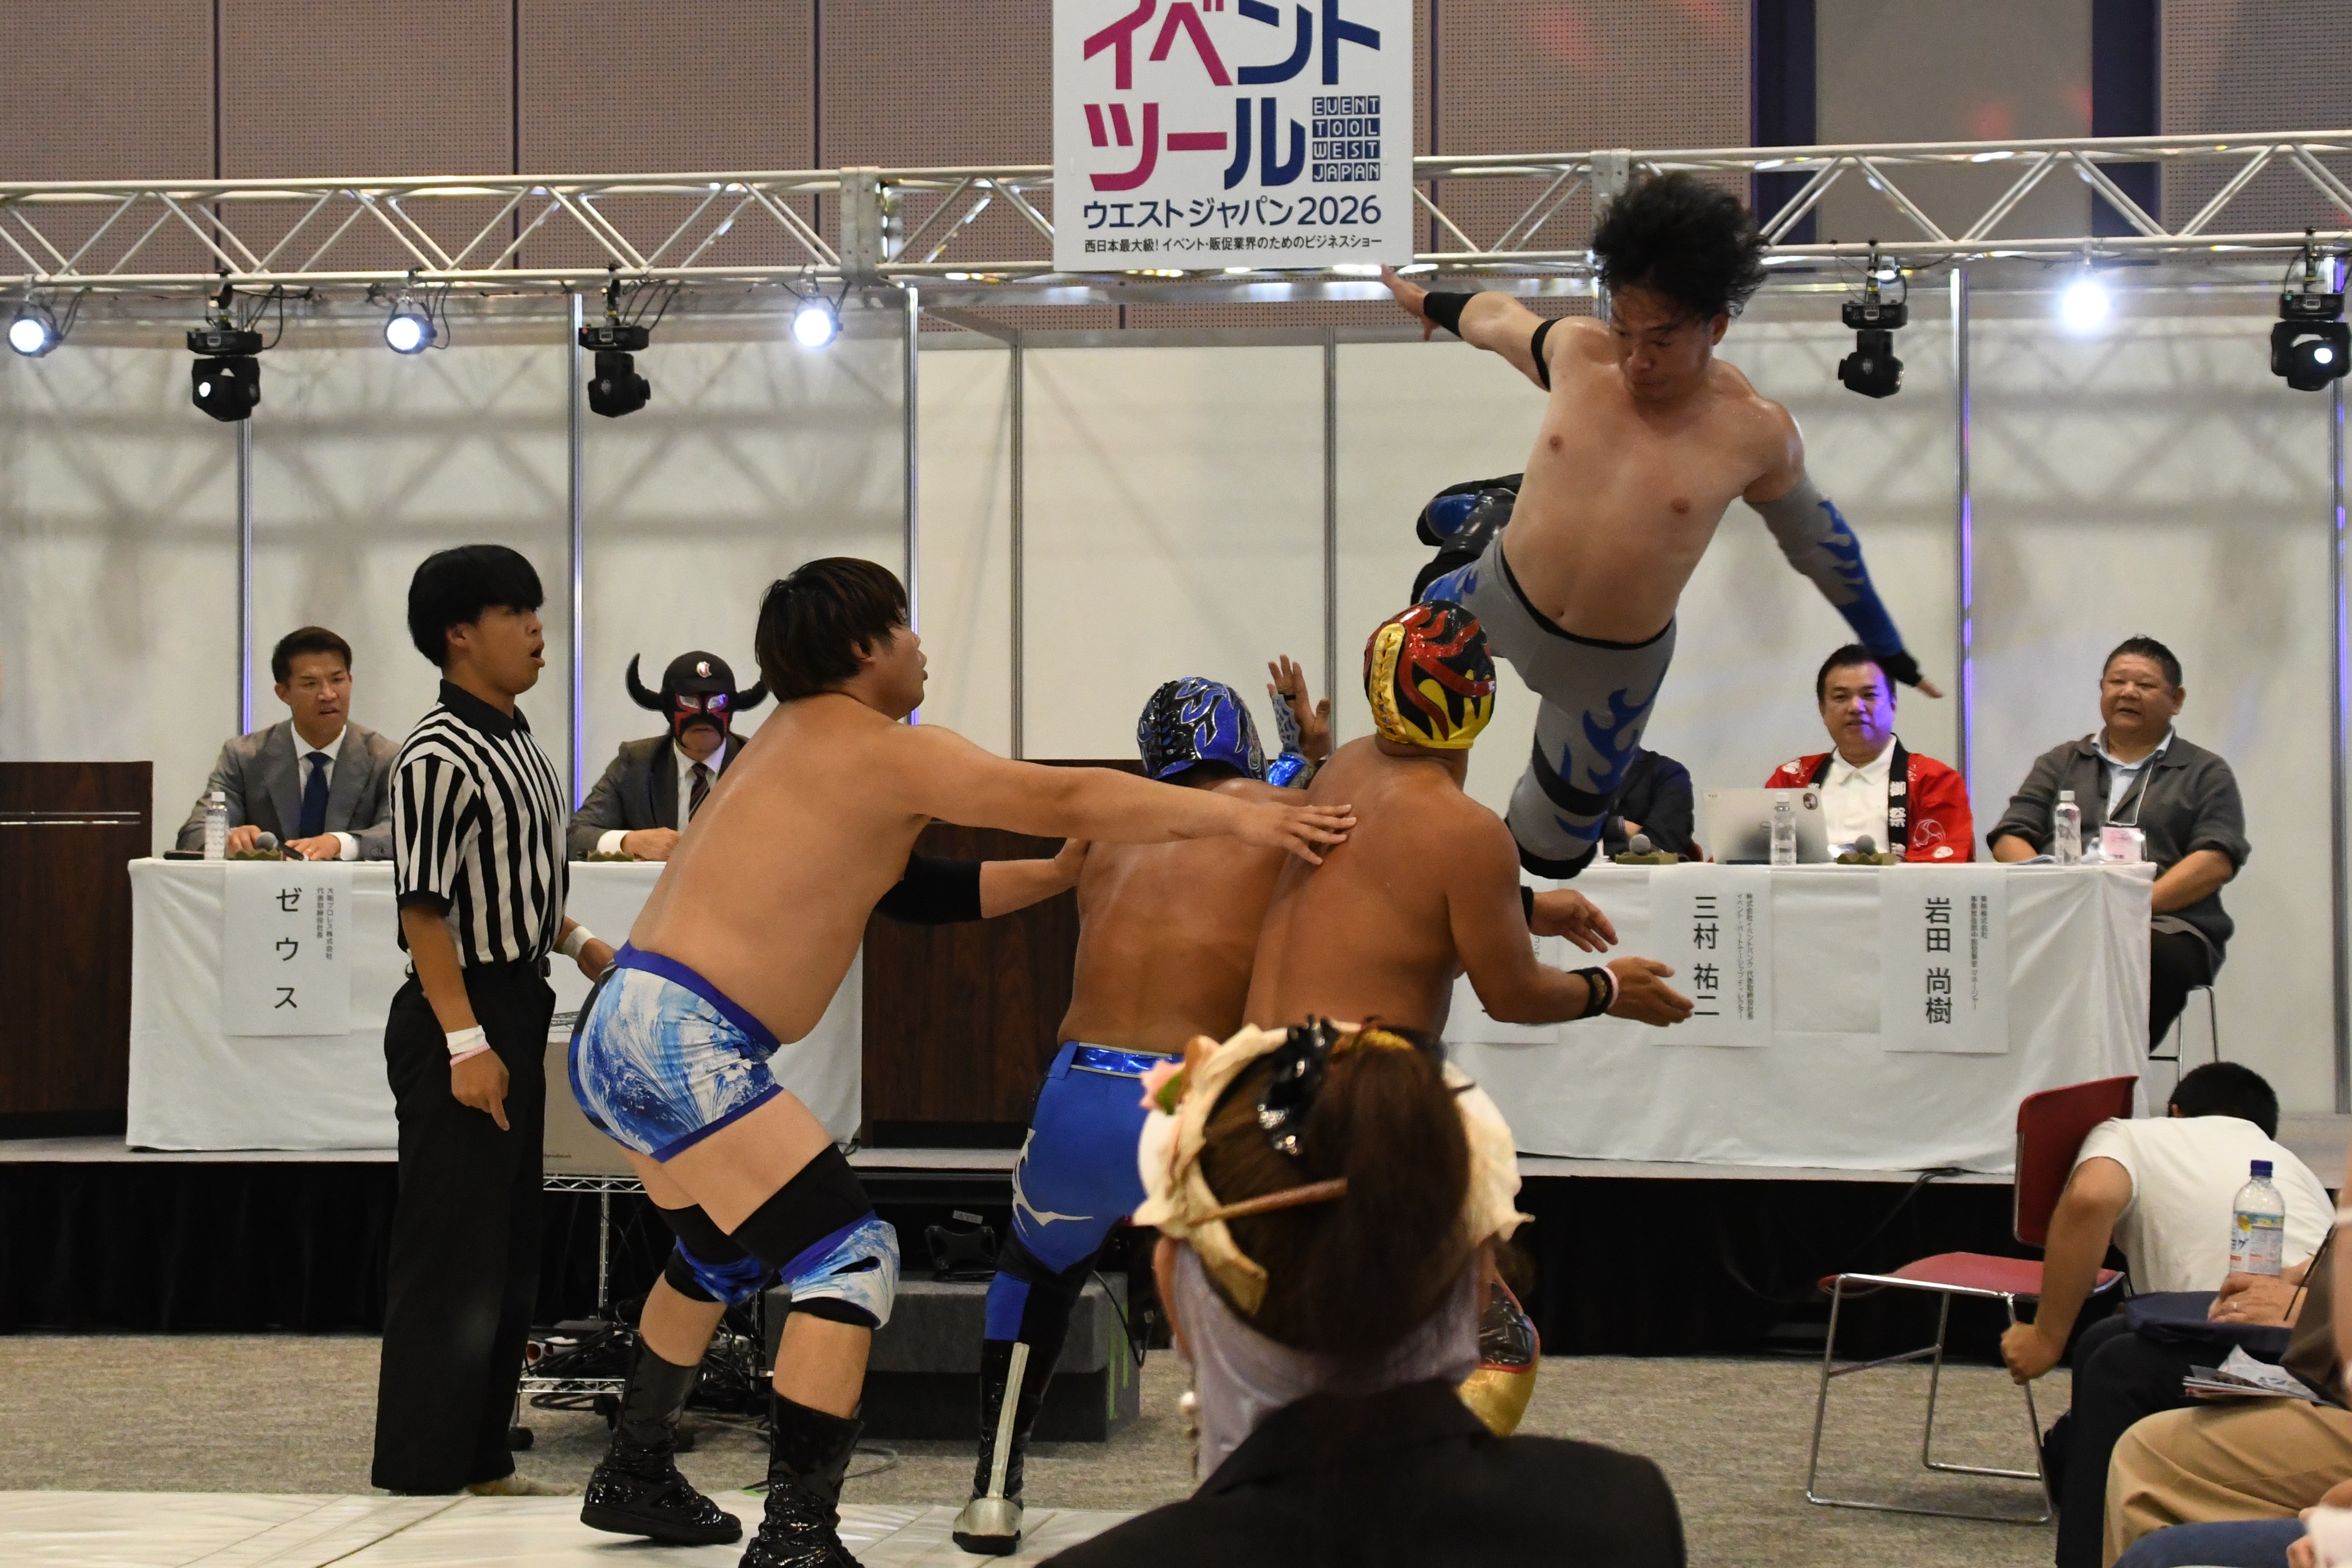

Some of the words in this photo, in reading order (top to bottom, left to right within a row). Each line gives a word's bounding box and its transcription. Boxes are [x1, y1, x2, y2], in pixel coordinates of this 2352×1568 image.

[1084, 0, 1380, 89] イベント
[1314, 98, 1379, 115] EVENT
[1315, 120, 1378, 136] TOOL
[1084, 97, 1307, 192] ツール
[1314, 141, 1378, 158] WEST
[1314, 164, 1379, 181] JAPAN
[275, 887, 302, 1008] ゼウス
[1694, 896, 1719, 950] 三村
[1925, 897, 1952, 953] 岩田
[1694, 963, 1720, 1016] 祐二
[1926, 967, 1953, 1024] 尚樹
